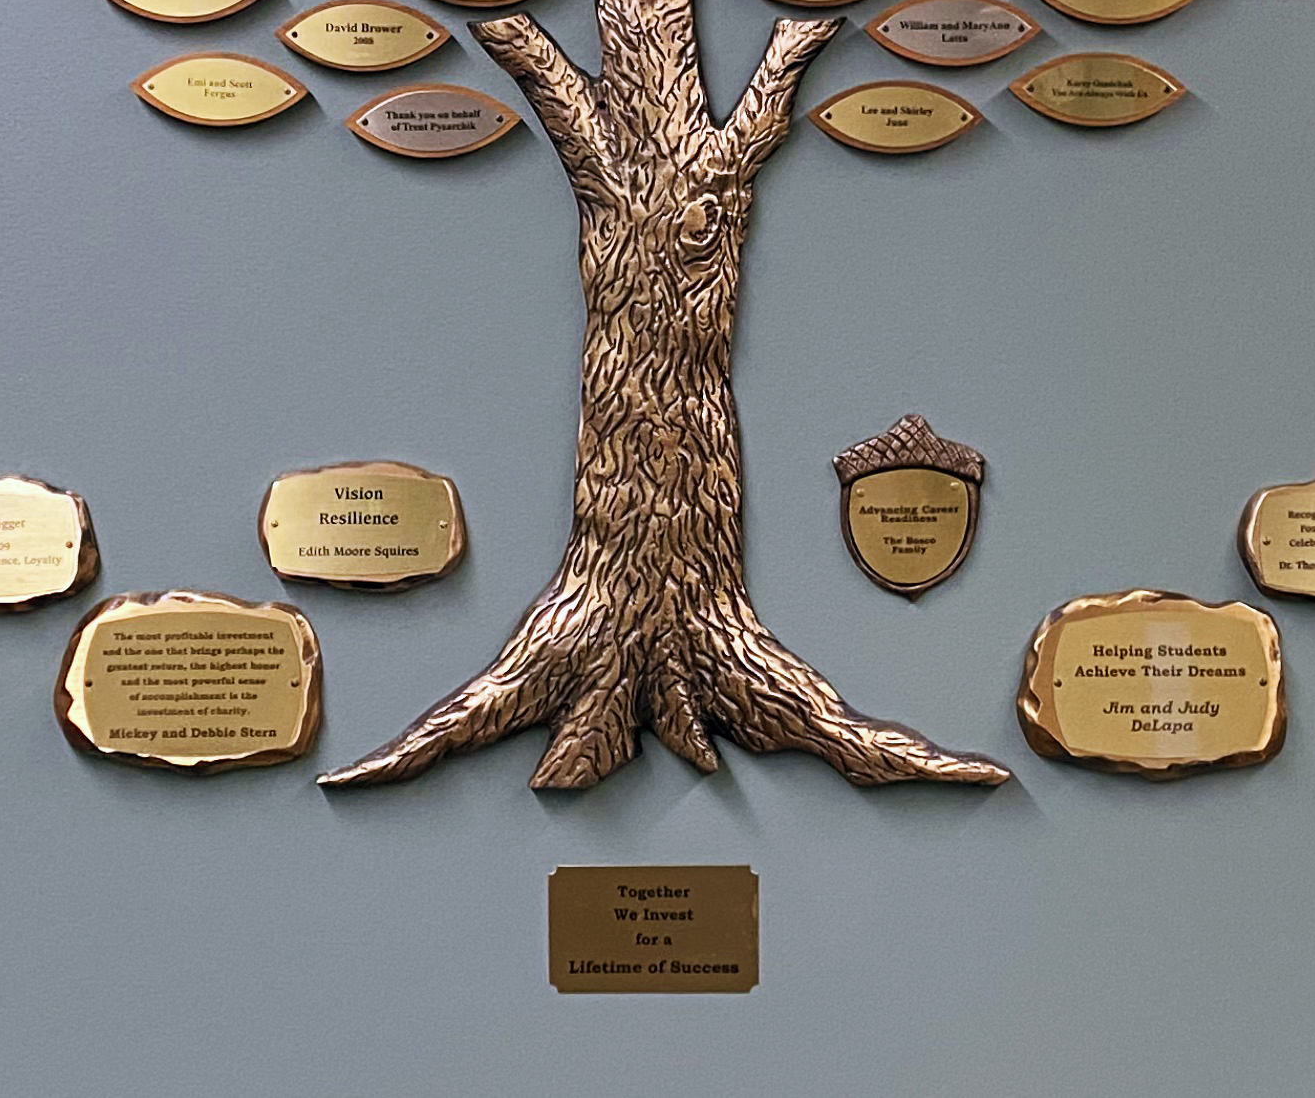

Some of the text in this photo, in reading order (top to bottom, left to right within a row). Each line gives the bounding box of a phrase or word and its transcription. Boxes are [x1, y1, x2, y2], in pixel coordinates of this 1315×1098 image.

[325, 22, 403, 34] David Brower
[334, 486, 384, 501] Vision
[319, 510, 399, 526] Resilience
[298, 545, 420, 560] Edith Moore Squires
[1092, 644, 1227, 661] Helping Students
[1074, 664, 1246, 678] Achieve Their Dreams
[1102, 700, 1220, 718] Jim and Judy
[108, 726, 278, 742] Mickey and Debbie Stern
[1130, 718, 1194, 735] DeLapa
[616, 884, 691, 902] Together
[613, 907, 694, 922] We Invest
[635, 932, 673, 946] for a
[568, 959, 740, 975] Lifetime of Success
